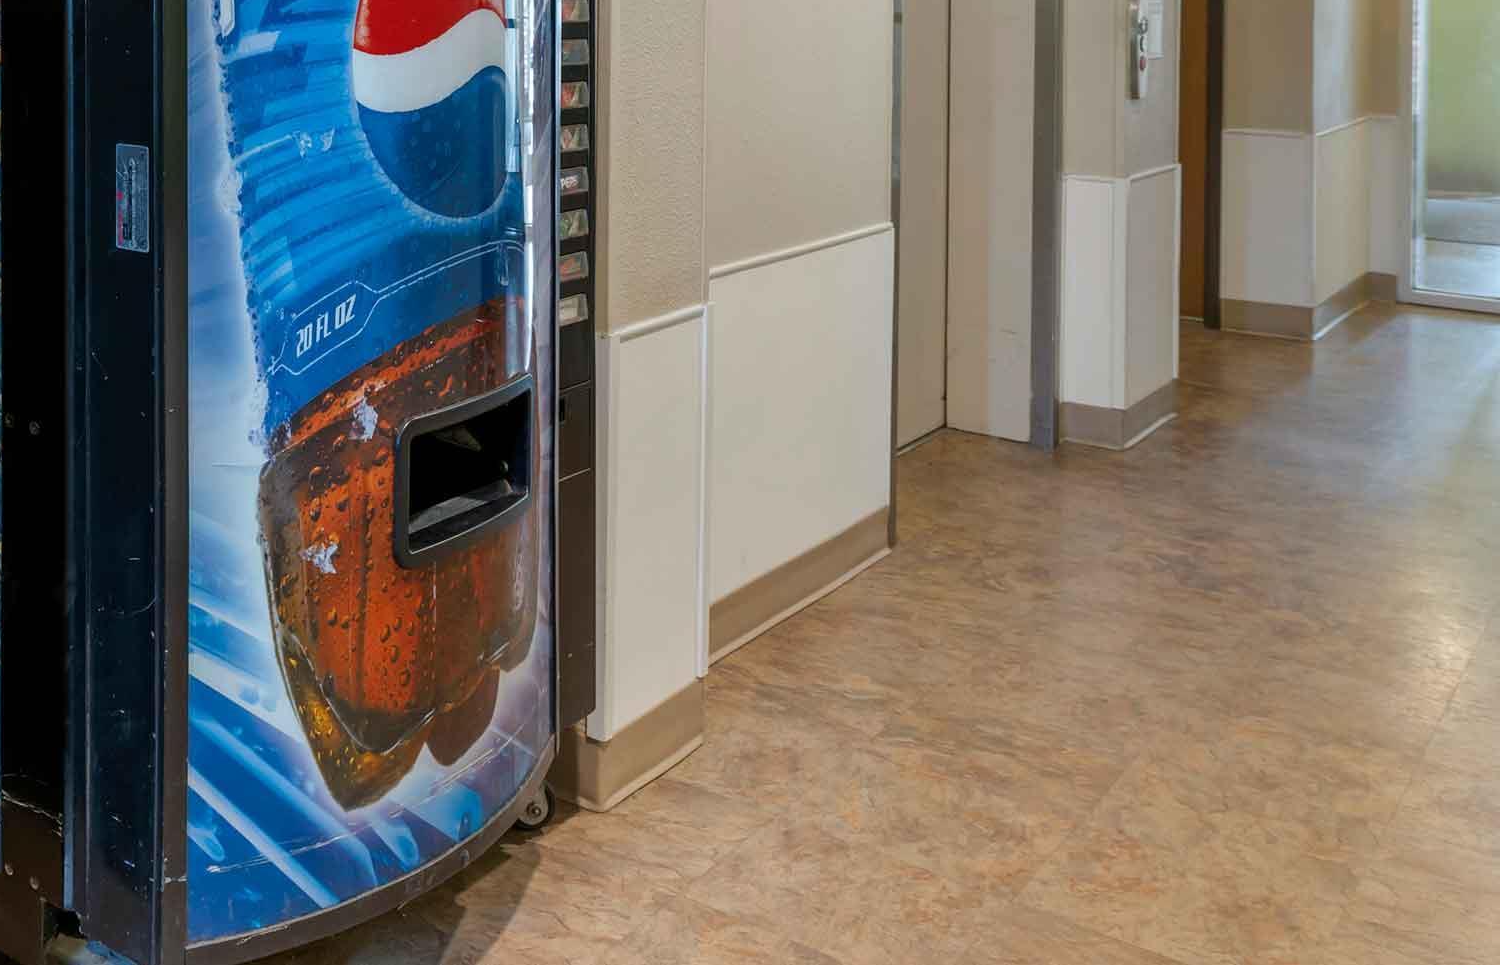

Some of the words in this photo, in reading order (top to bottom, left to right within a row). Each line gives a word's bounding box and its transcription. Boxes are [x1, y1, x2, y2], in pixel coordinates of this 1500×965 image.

[296, 322, 313, 358] 20
[316, 310, 332, 344] FL
[335, 294, 357, 329] OZ
